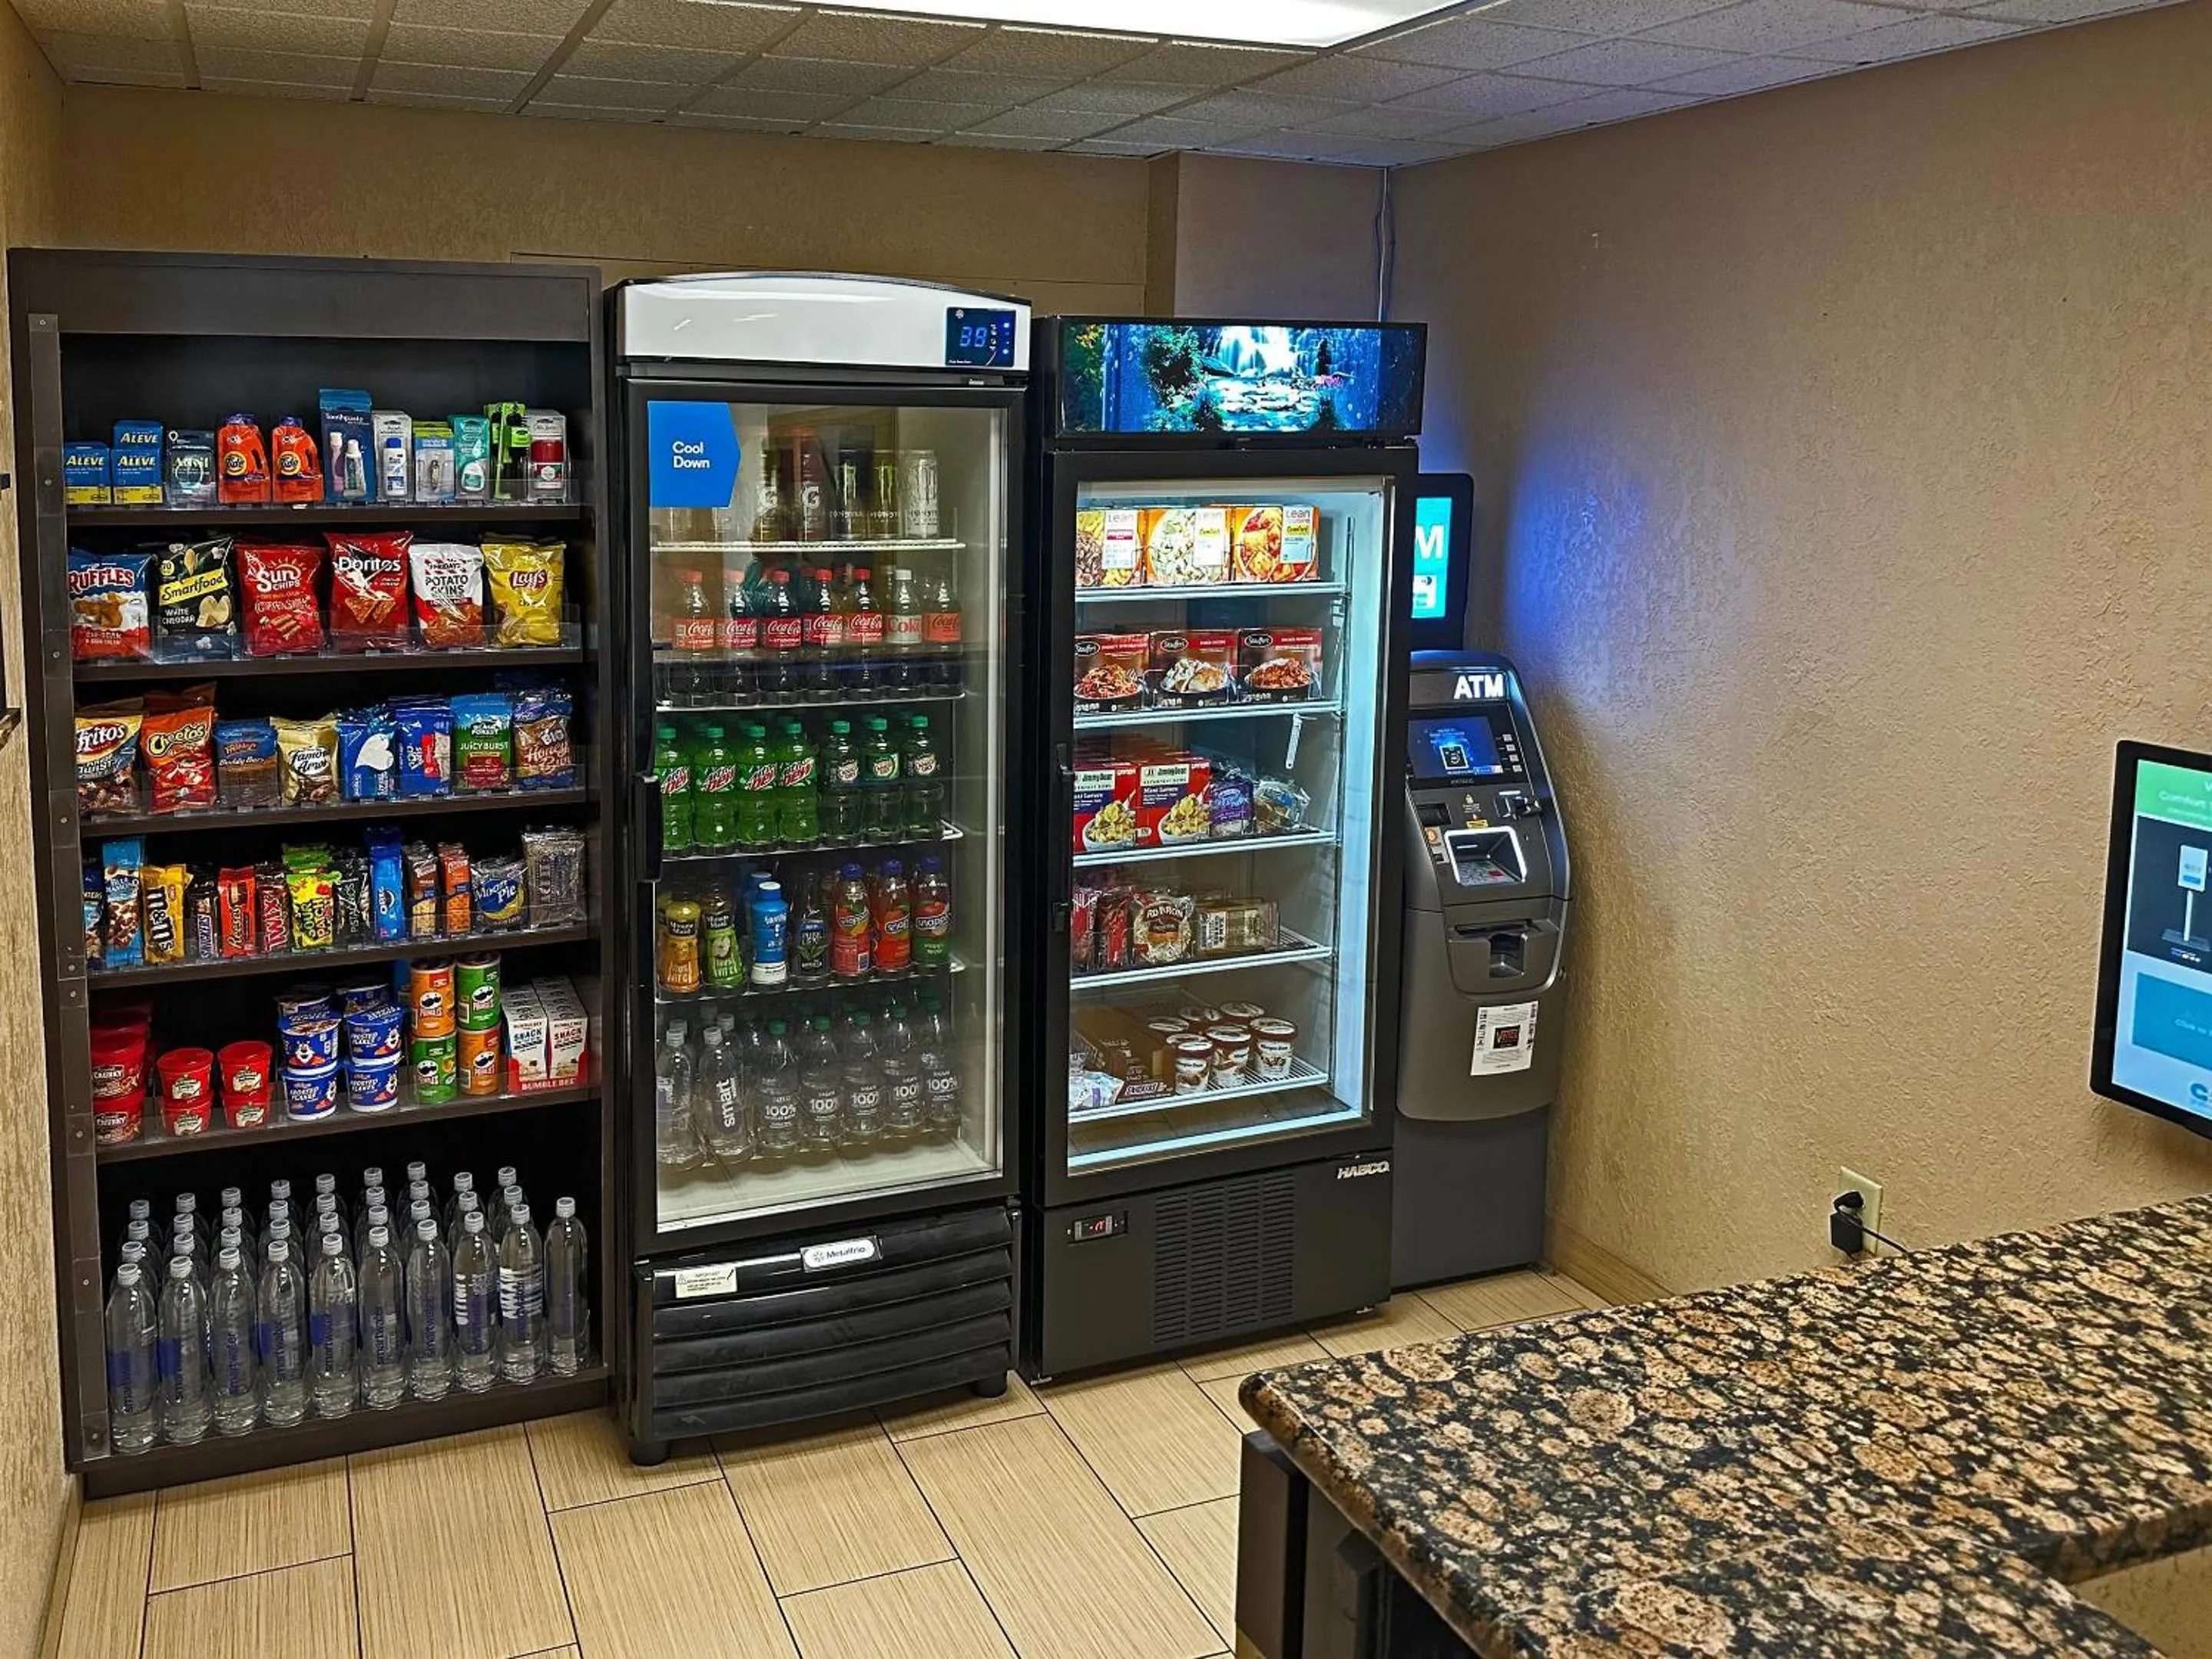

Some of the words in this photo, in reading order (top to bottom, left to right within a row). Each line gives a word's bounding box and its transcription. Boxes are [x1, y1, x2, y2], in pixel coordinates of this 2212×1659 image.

[121, 433, 157, 444] ALEVE
[672, 441, 704, 455] Cool
[66, 455, 104, 466] ALEVE
[118, 455, 156, 466] ALEVE
[673, 455, 710, 469] Down
[1286, 509, 1310, 518] Lean
[338, 557, 401, 571] Doritos
[68, 567, 134, 594] RUFFLES
[256, 568, 300, 593] Sun
[425, 575, 469, 586] POTATO
[161, 575, 224, 601] Smartfood
[1453, 675, 1504, 700] ATM
[77, 724, 126, 753] Fritos
[148, 724, 205, 757] Cheetos
[553, 1028, 582, 1040] SNACK
[716, 1078, 736, 1128] smart
[1336, 1161, 1391, 1181] HABCO
